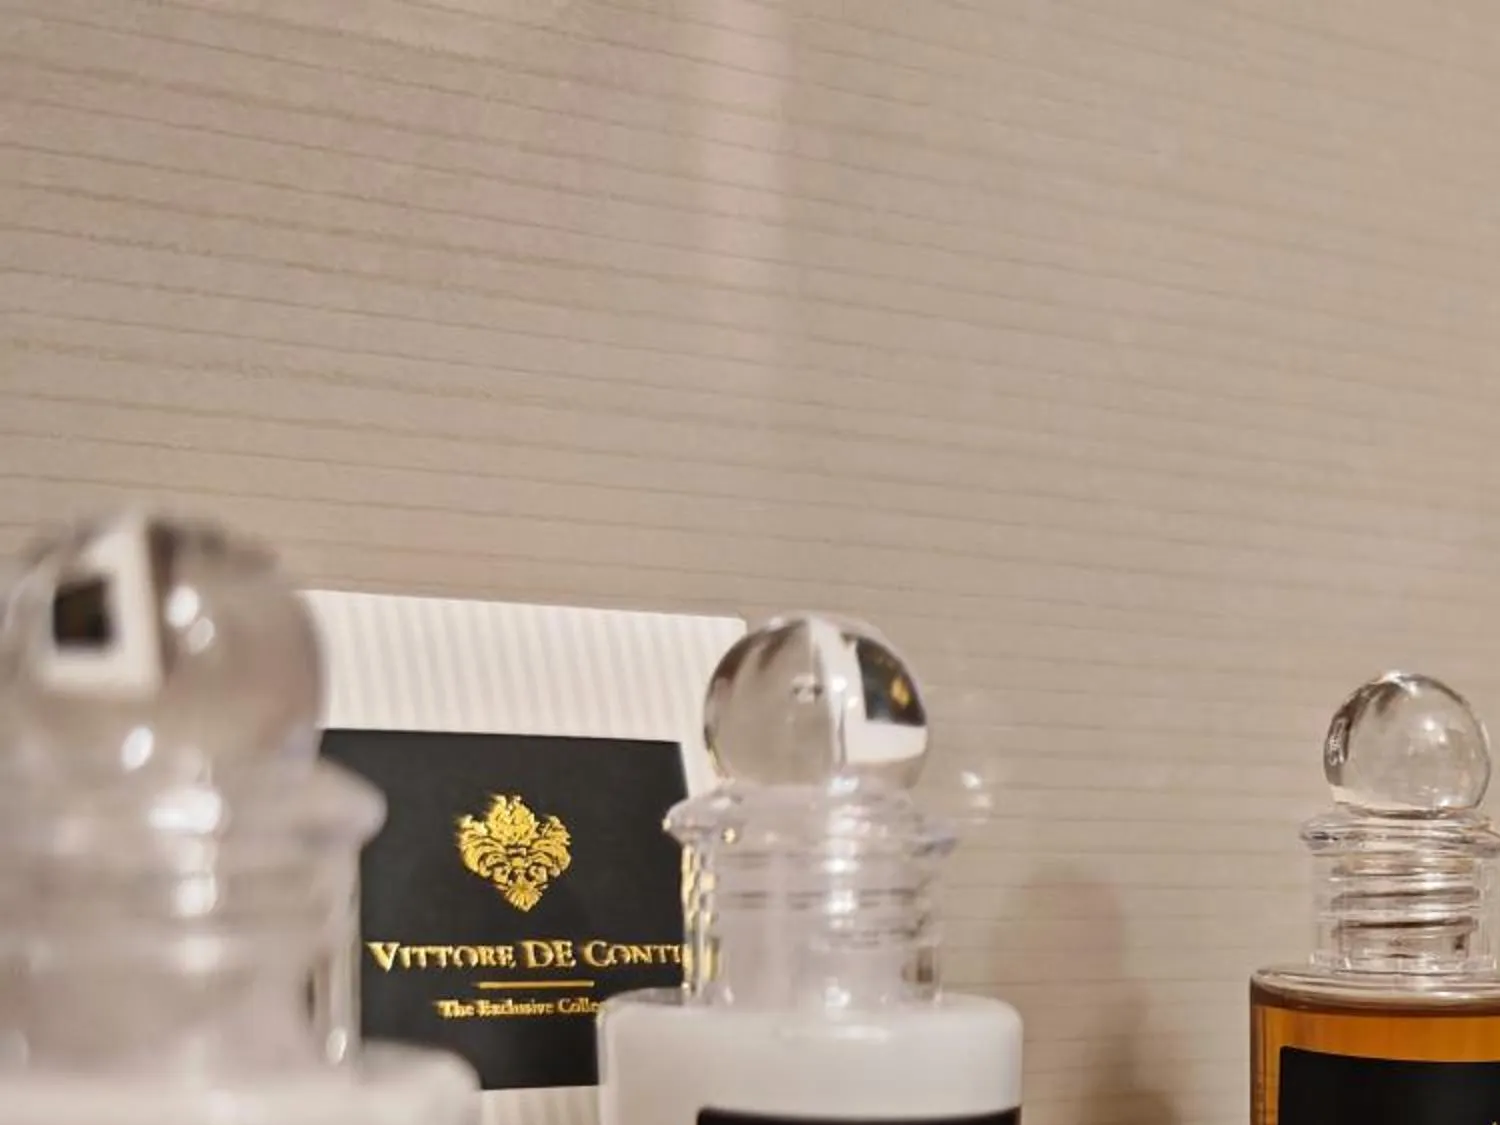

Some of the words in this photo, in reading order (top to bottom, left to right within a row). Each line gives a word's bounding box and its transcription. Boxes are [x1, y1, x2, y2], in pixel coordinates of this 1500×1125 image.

[367, 941, 516, 972] VITTORE
[521, 940, 576, 969] DE
[437, 1000, 474, 1018] The
[478, 999, 554, 1016] Exclusive
